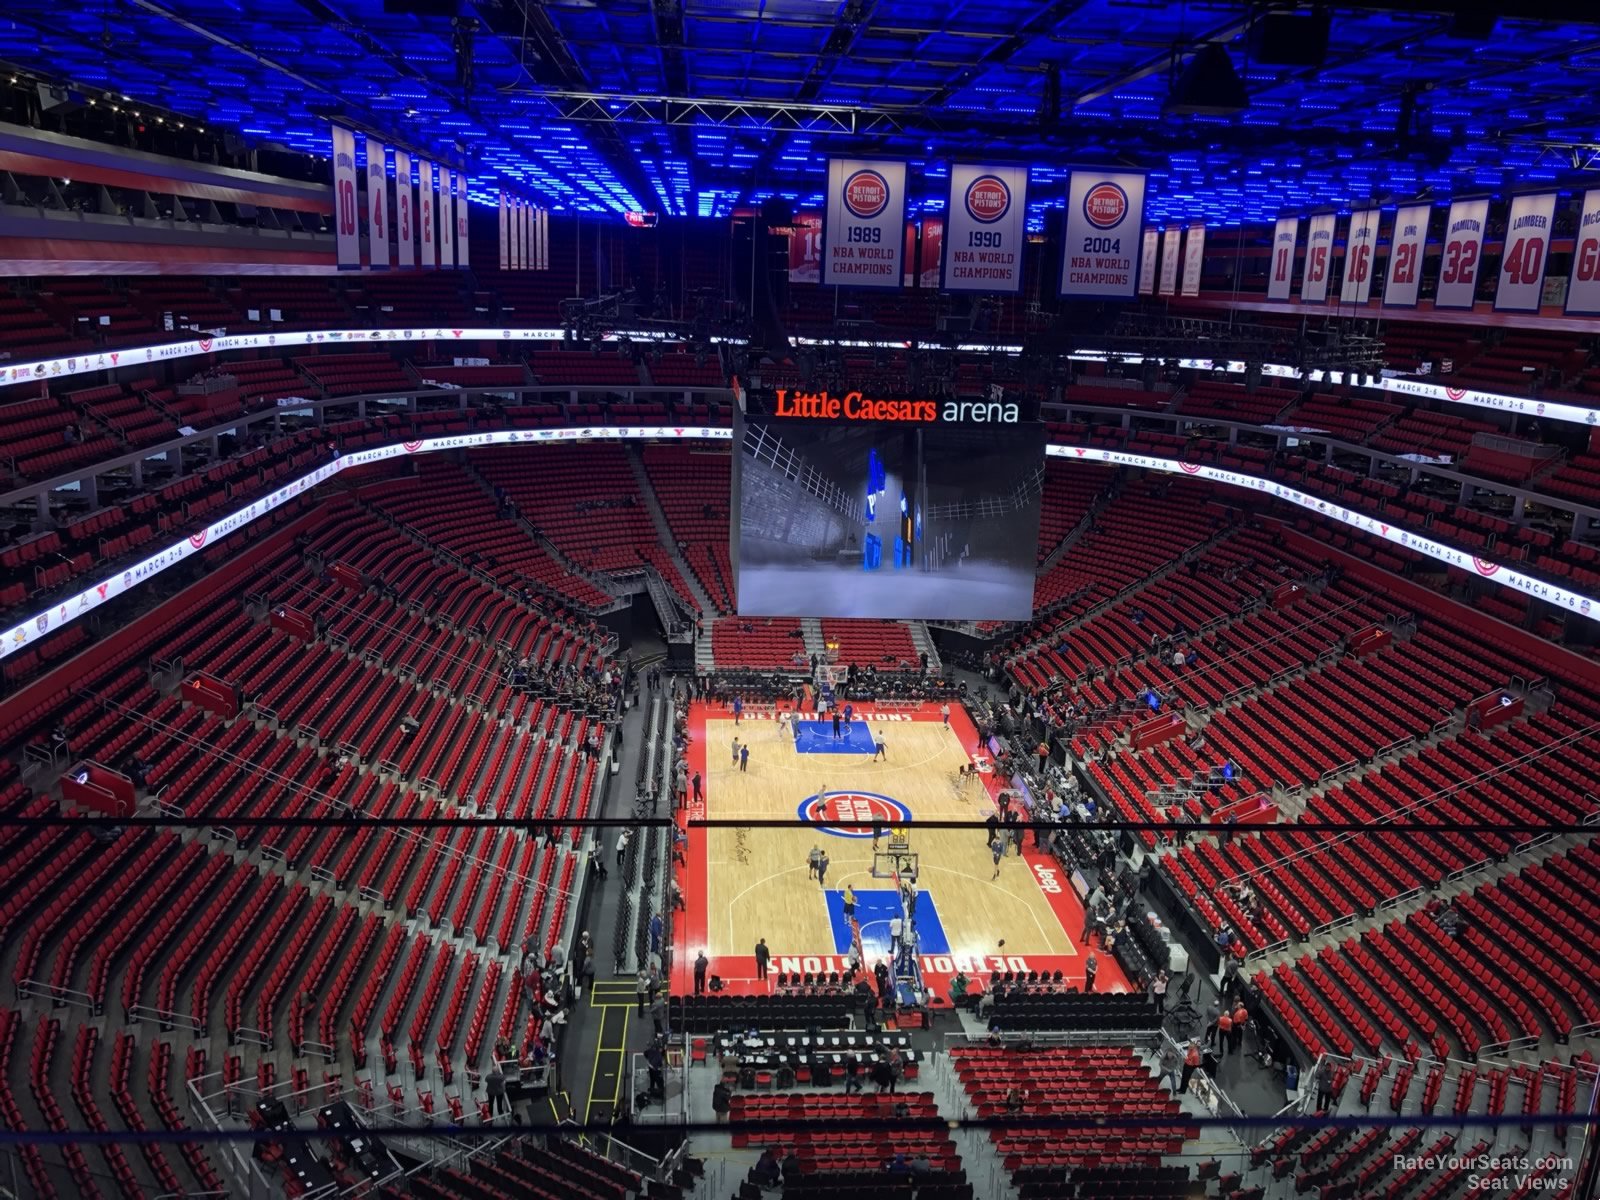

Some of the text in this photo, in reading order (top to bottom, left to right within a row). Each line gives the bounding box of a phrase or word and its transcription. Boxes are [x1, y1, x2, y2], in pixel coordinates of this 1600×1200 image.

[853, 186, 880, 194] DETROIT
[974, 191, 1002, 200] DETROIT
[852, 194, 880, 202] PISTONS
[974, 199, 1002, 208] PISTONS
[1093, 198, 1120, 206] DETROIT
[338, 179, 354, 235] 10
[374, 188, 383, 238] 4
[1092, 206, 1119, 214] PISTONS
[401, 194, 409, 240] 3
[424, 200, 431, 242] 2
[1513, 214, 1547, 230] LAIMBEER
[1404, 225, 1417, 237] BING
[1452, 219, 1481, 234] HAMILTON
[848, 226, 881, 244] 1989
[968, 231, 1002, 248] 1990
[833, 247, 894, 260] NBA WORLD
[1083, 238, 1120, 254] 2004
[954, 252, 975, 263] NBA
[978, 252, 1014, 264] WORLD
[1071, 257, 1130, 270] NBA WORLD
[1275, 248, 1288, 282] 11
[1308, 247, 1327, 282] 15
[1348, 244, 1370, 282] 16
[1393, 243, 1418, 283] 21
[1442, 240, 1478, 284] 32
[1504, 237, 1544, 285] 40
[833, 262, 892, 275] CHAMPIONS
[953, 266, 1012, 280] CHAMPIONS
[1070, 272, 1128, 286] CHAMPIONS
[160, 345, 194, 356] MARCH 2-6
[218, 338, 239, 348] MARCH
[1396, 383, 1438, 396] MARCH 2-6
[776, 390, 1019, 423] Little Caesars arena
[1474, 396, 1524, 410] MARCH 2-6
[433, 439, 464, 448] MARCH
[357, 448, 397, 462] MARCH 2-6
[1114, 455, 1168, 468] MARCH 2-6
[1208, 471, 1255, 486] MARCH 2-6
[214, 518, 237, 536] MARCH
[1411, 539, 1462, 564] MARCH 2-6
[136, 548, 183, 579] MARCH 2-6
[1509, 575, 1575, 607] MARCH 2-6
[1034, 864, 1062, 894] Jeep
